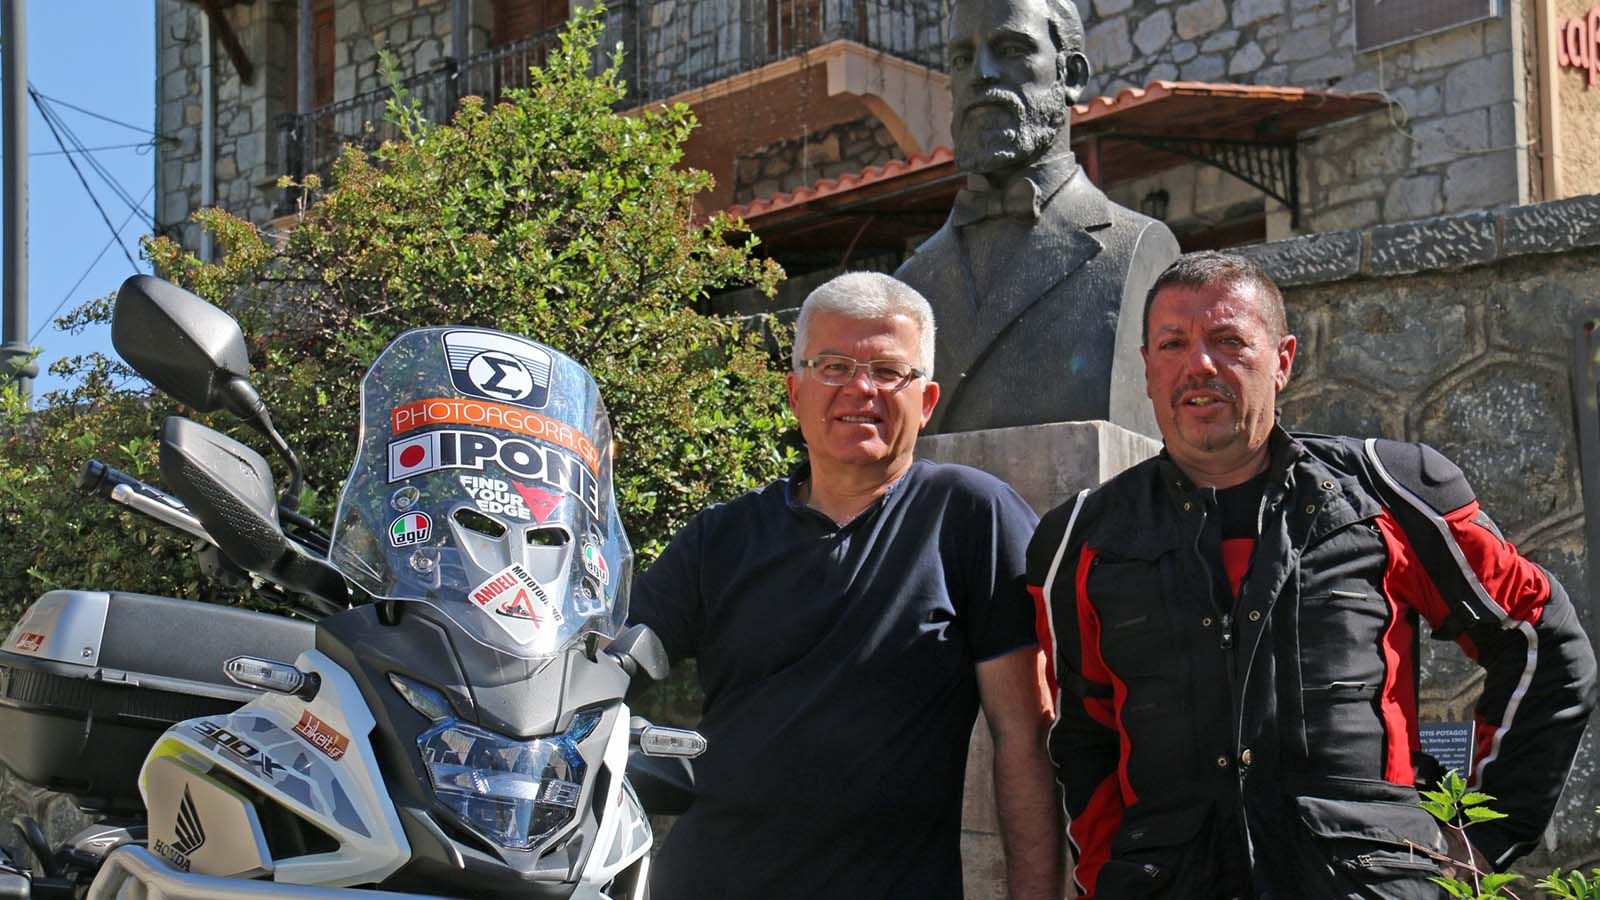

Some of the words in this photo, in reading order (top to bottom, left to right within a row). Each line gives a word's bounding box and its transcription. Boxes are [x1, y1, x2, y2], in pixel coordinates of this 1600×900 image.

[437, 431, 599, 520] IPONE
[459, 475, 509, 492] FIND
[464, 486, 524, 507] YOUR
[476, 499, 531, 520] EDGE
[473, 572, 519, 606] ANDELI
[191, 720, 288, 780] 500X
[153, 838, 191, 872] HONDA
